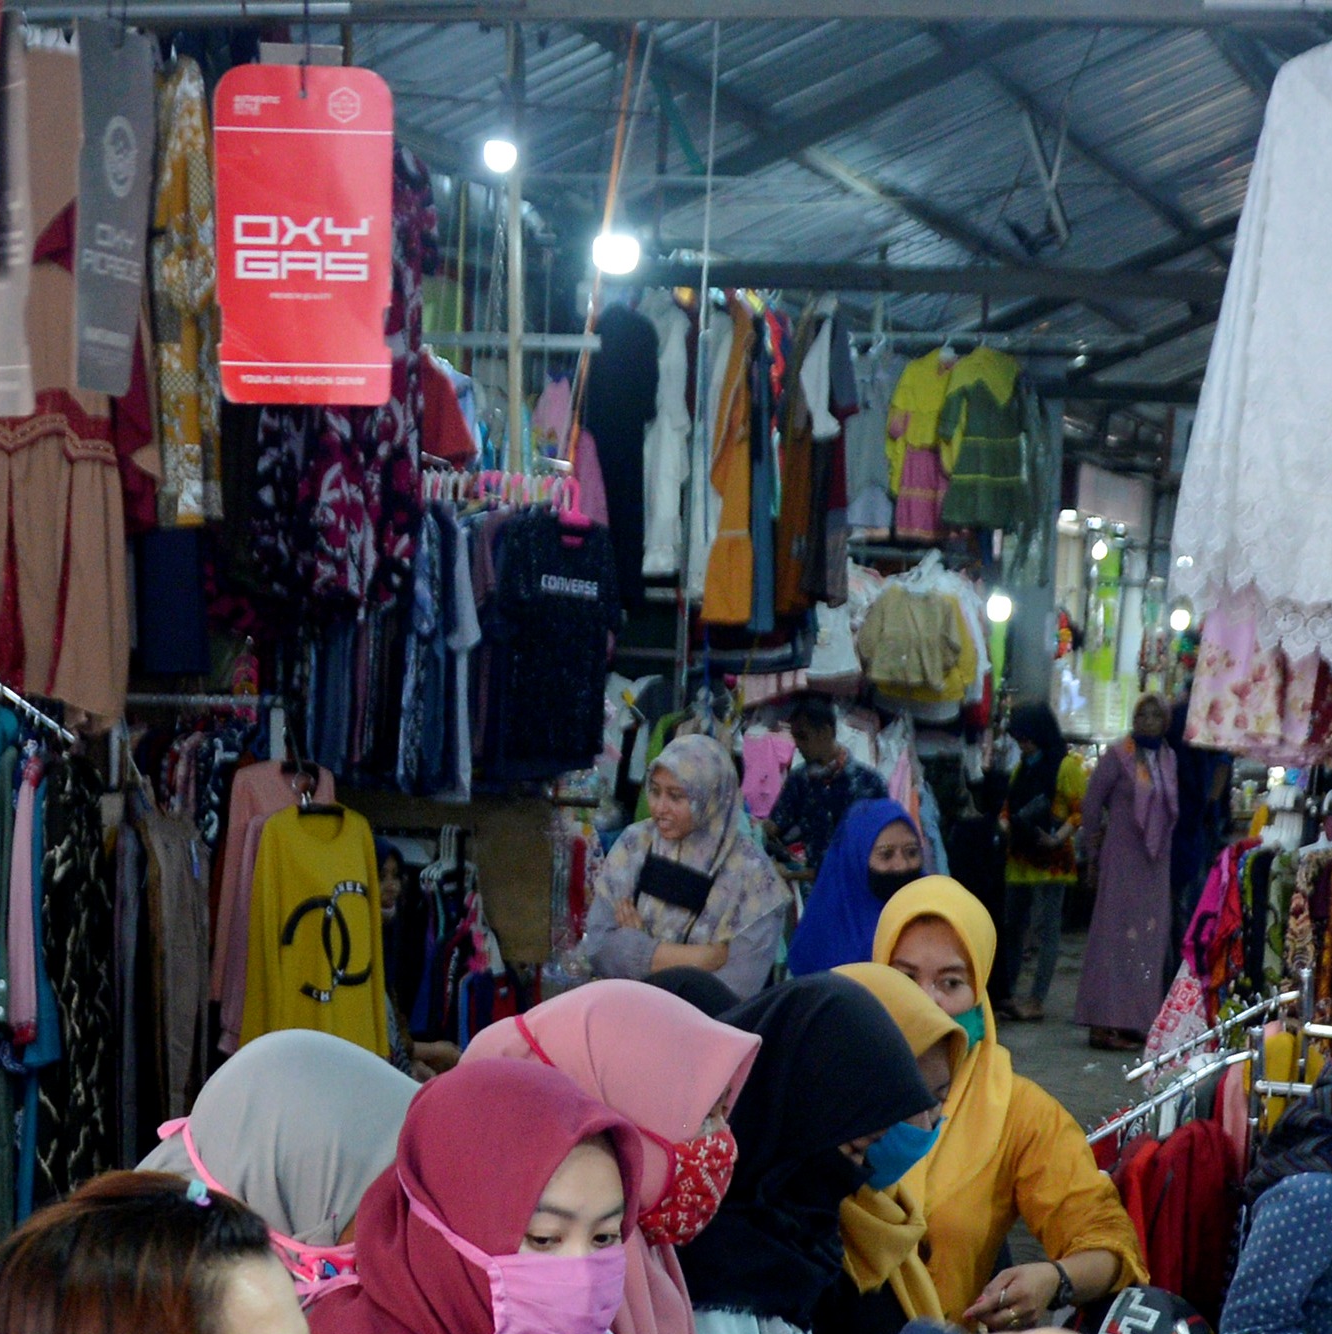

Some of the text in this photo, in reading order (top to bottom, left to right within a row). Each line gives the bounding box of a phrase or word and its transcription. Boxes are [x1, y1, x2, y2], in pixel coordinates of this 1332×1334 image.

[234, 215, 369, 246] OXY
[236, 249, 369, 281] GAS
[541, 574, 598, 597] CONVERSE
